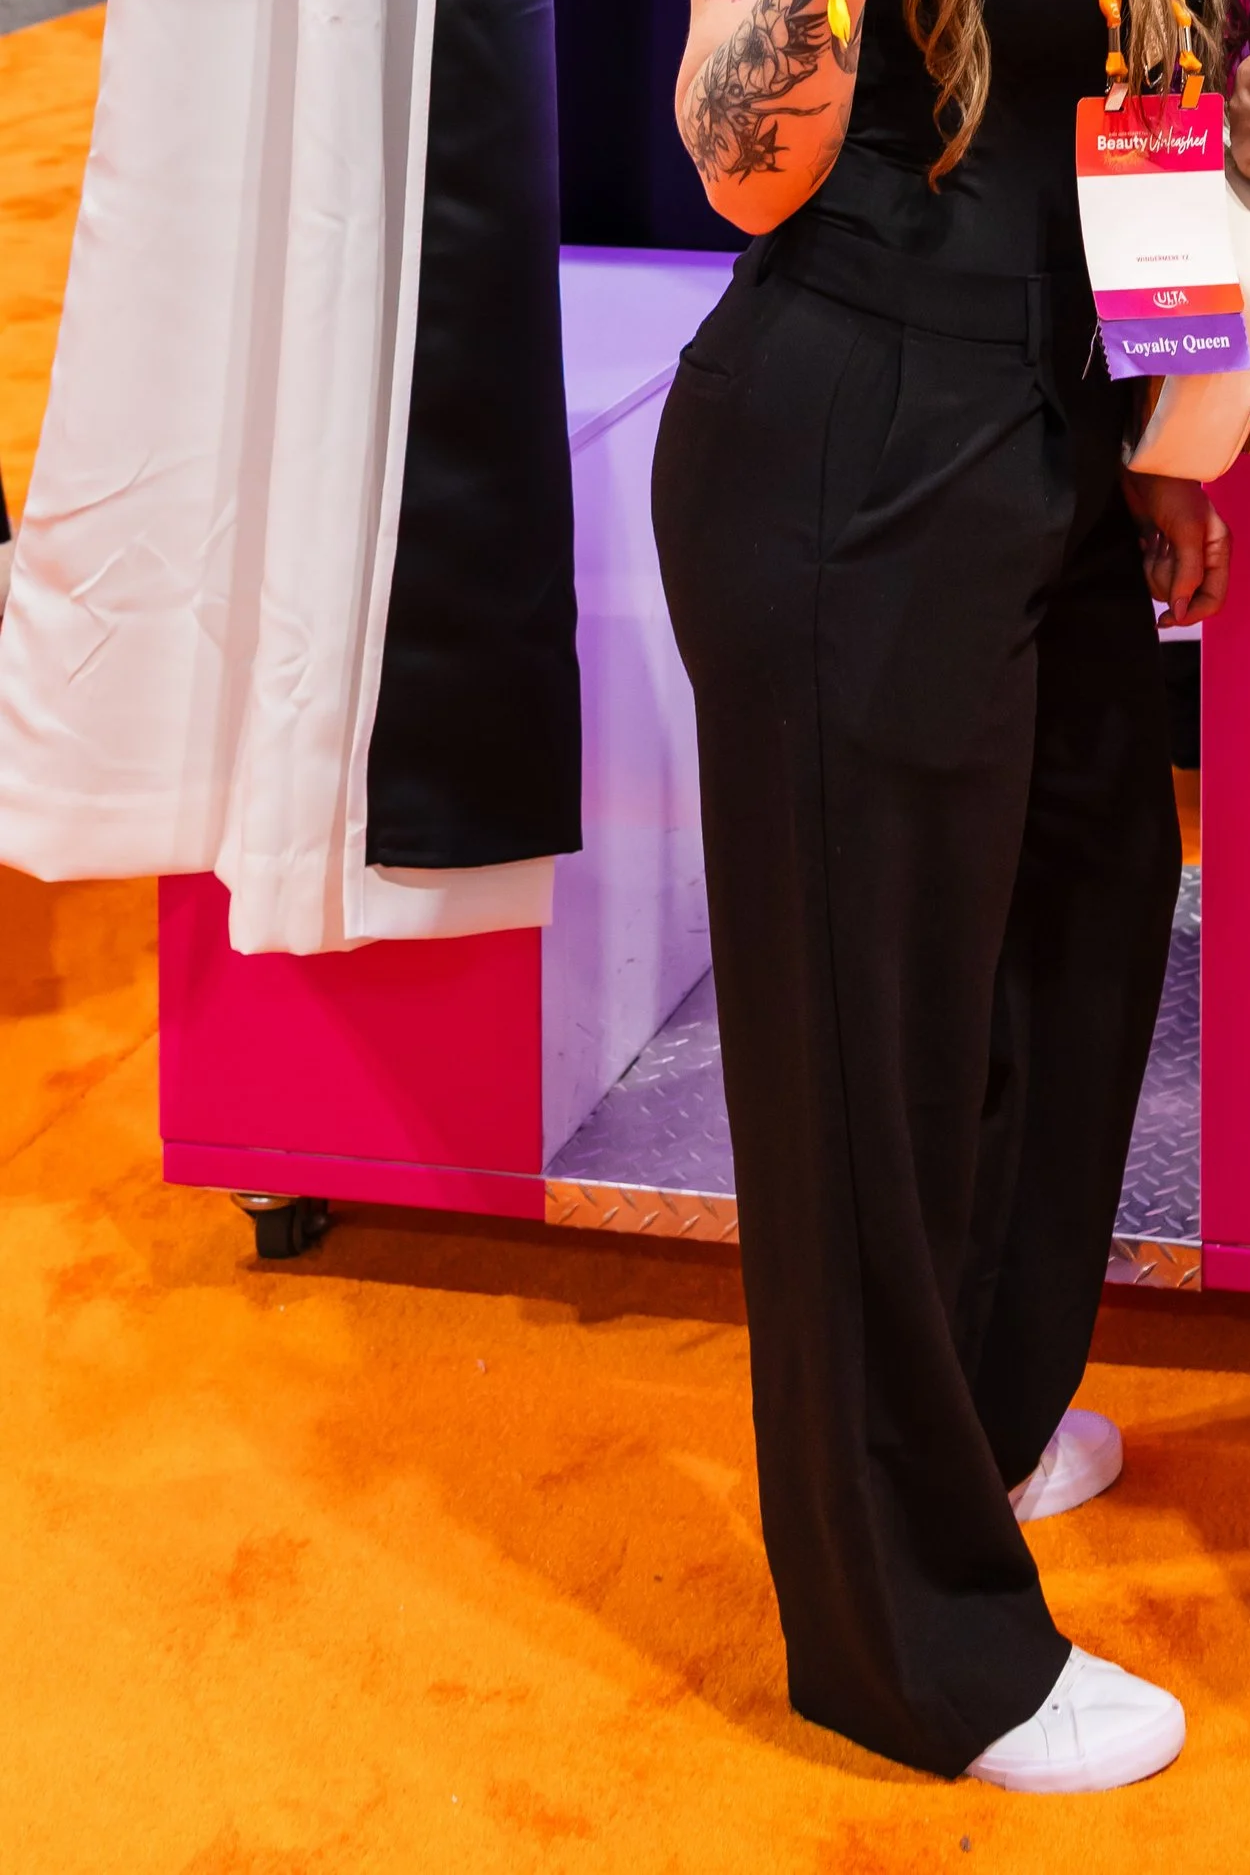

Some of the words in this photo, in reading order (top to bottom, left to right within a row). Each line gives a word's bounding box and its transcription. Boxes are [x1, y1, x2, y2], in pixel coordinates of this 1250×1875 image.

[1097, 134, 1148, 152] Beauty
[1149, 125, 1208, 155] Unleashed
[1153, 290, 1188, 308] ULTA
[1122, 336, 1179, 357] Loyalty
[1182, 334, 1230, 354] Queen
